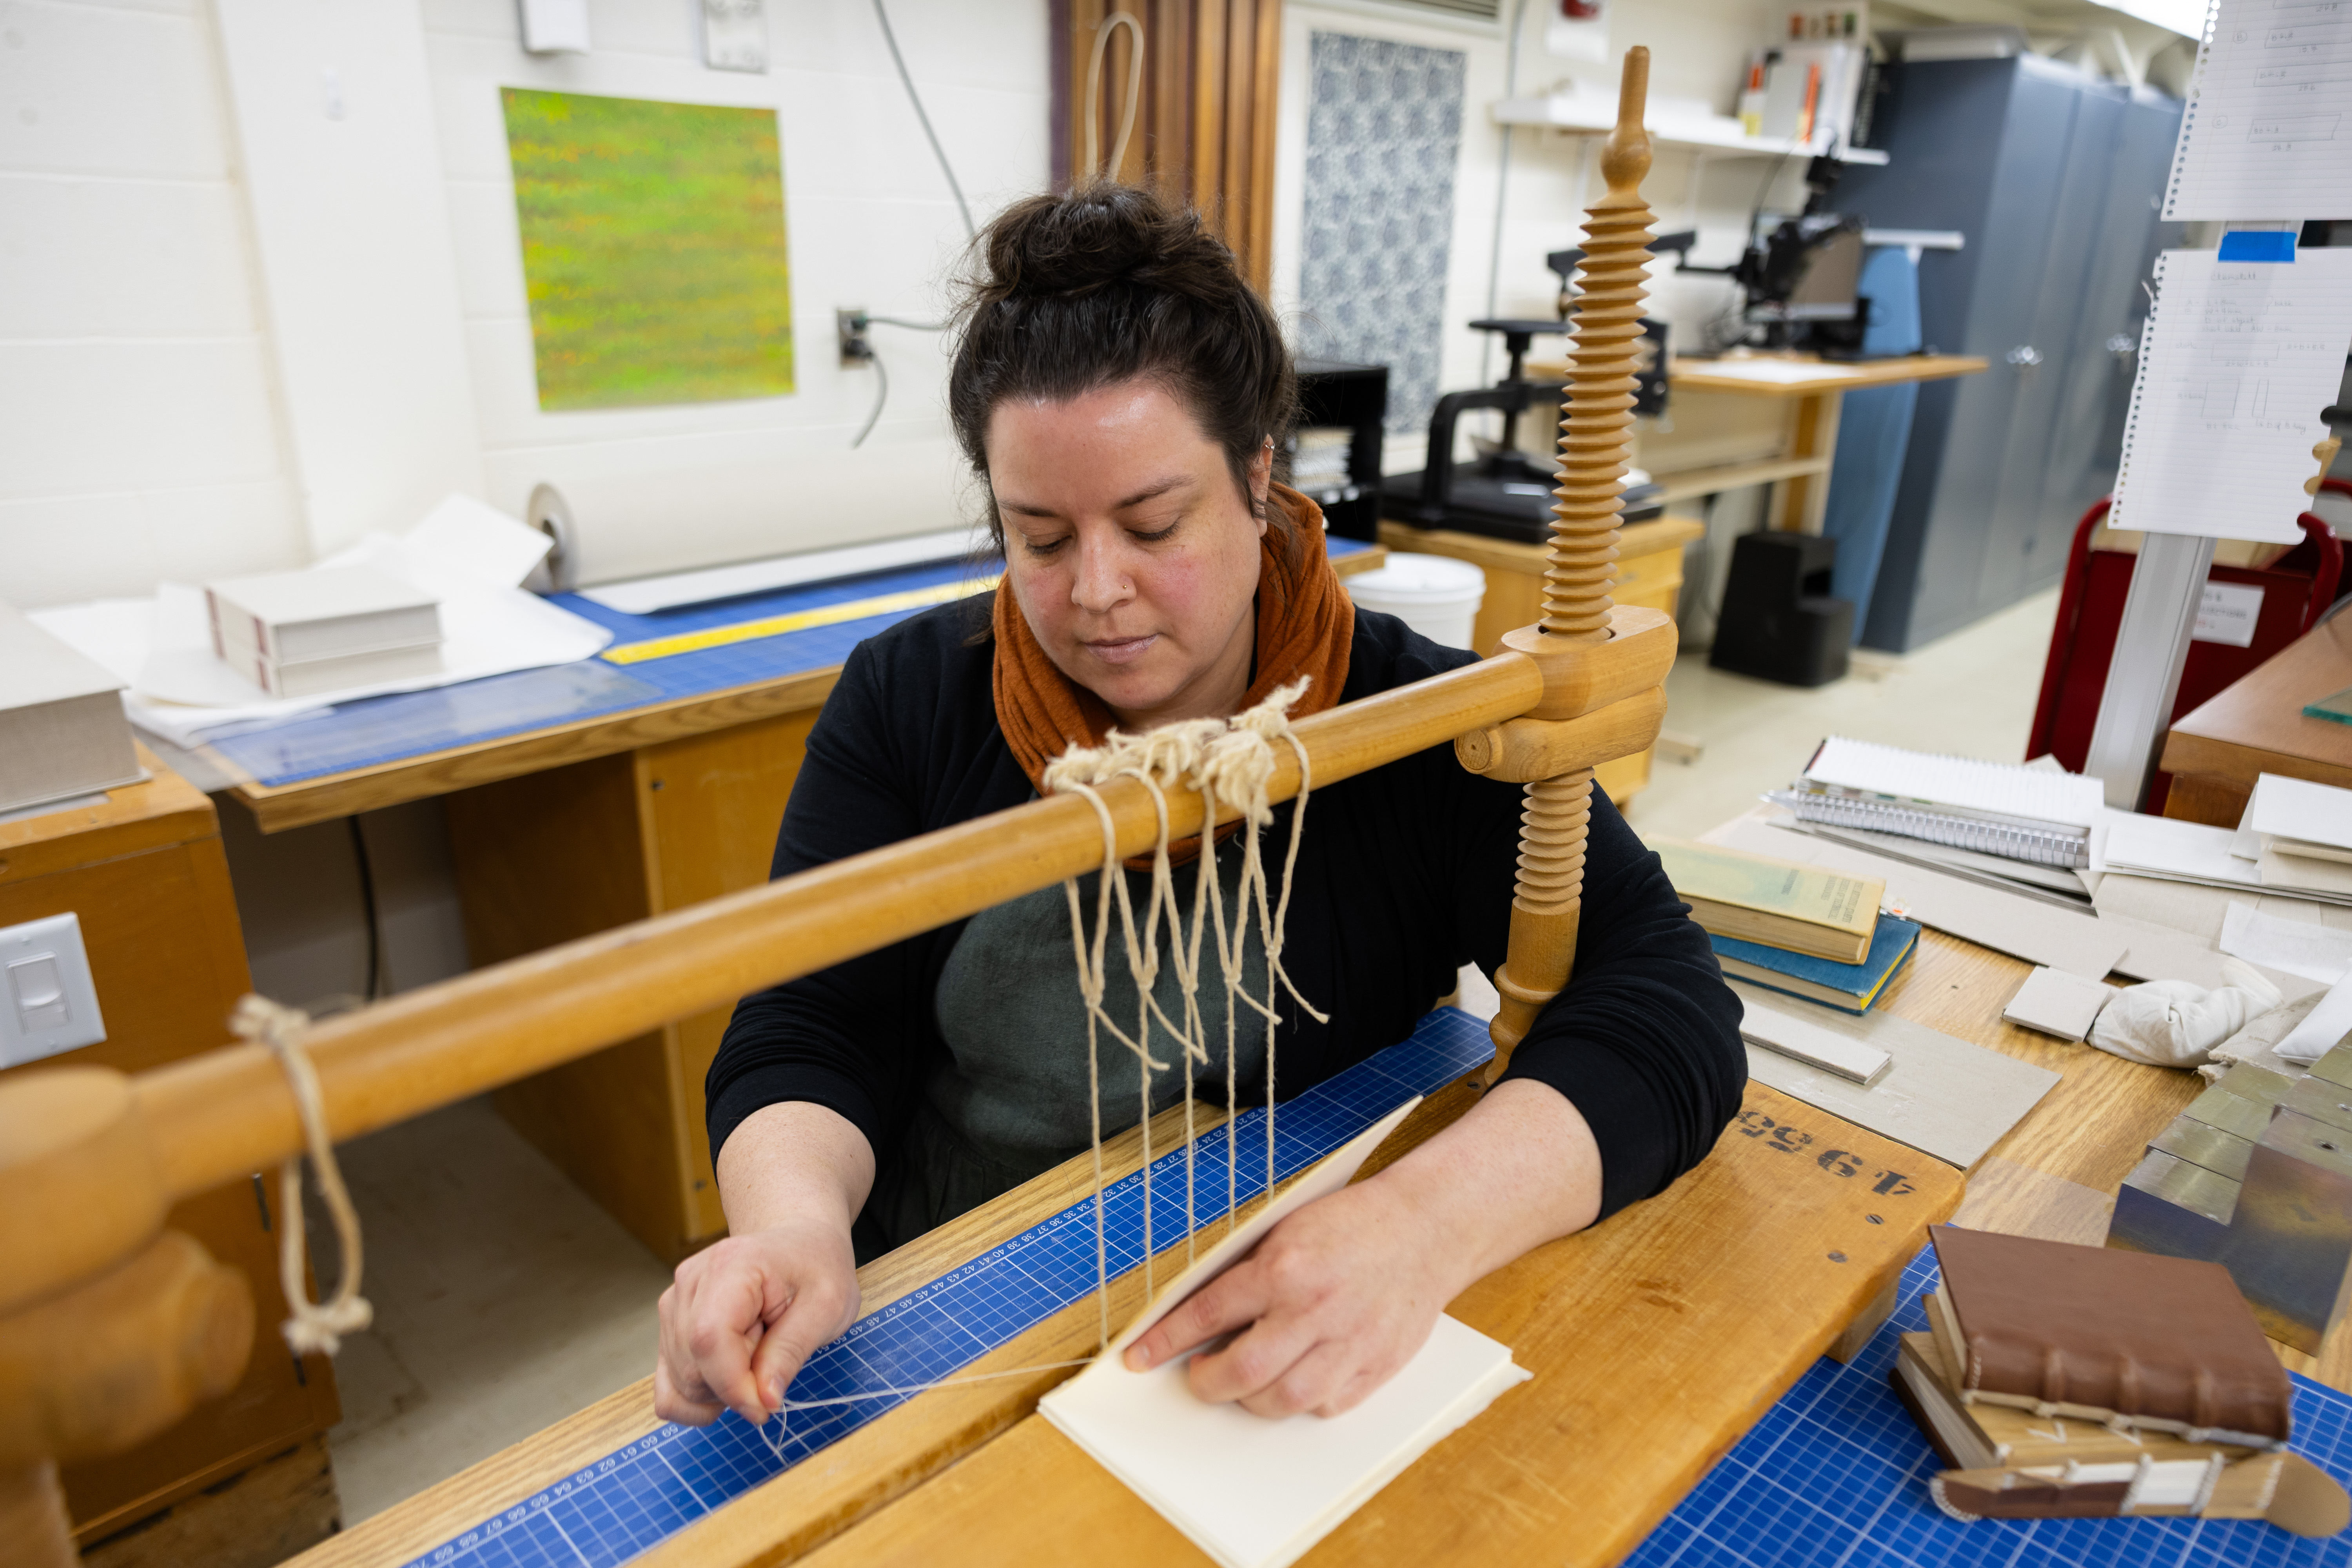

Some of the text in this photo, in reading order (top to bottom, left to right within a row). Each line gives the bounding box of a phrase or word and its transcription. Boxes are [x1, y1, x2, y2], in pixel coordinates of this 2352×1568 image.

[1167, 1155, 1178, 1163] 27
[1154, 1161, 1166, 1170] 28
[1103, 1189, 1116, 1197] 32
[1076, 1203, 1090, 1212] 34
[1063, 1210, 1076, 1219] 35
[1049, 1218, 1063, 1227] 36
[1037, 1225, 1049, 1234] 37
[1021, 1233, 1034, 1242] 38
[1007, 1241, 1020, 1250] 39
[992, 1249, 1005, 1258] 40
[978, 1257, 990, 1266] 41
[962, 1265, 975, 1274] 42
[947, 1273, 959, 1282] 43
[932, 1282, 944, 1291] 44
[915, 1290, 928, 1300] 45
[900, 1299, 912, 1308] 46
[885, 1307, 896, 1318] 47
[866, 1316, 879, 1326] 48
[849, 1326, 862, 1336] 49
[641, 1435, 657, 1449] 60
[621, 1446, 637, 1460] 61
[598, 1458, 615, 1472] 62
[554, 1481, 572, 1496] 64
